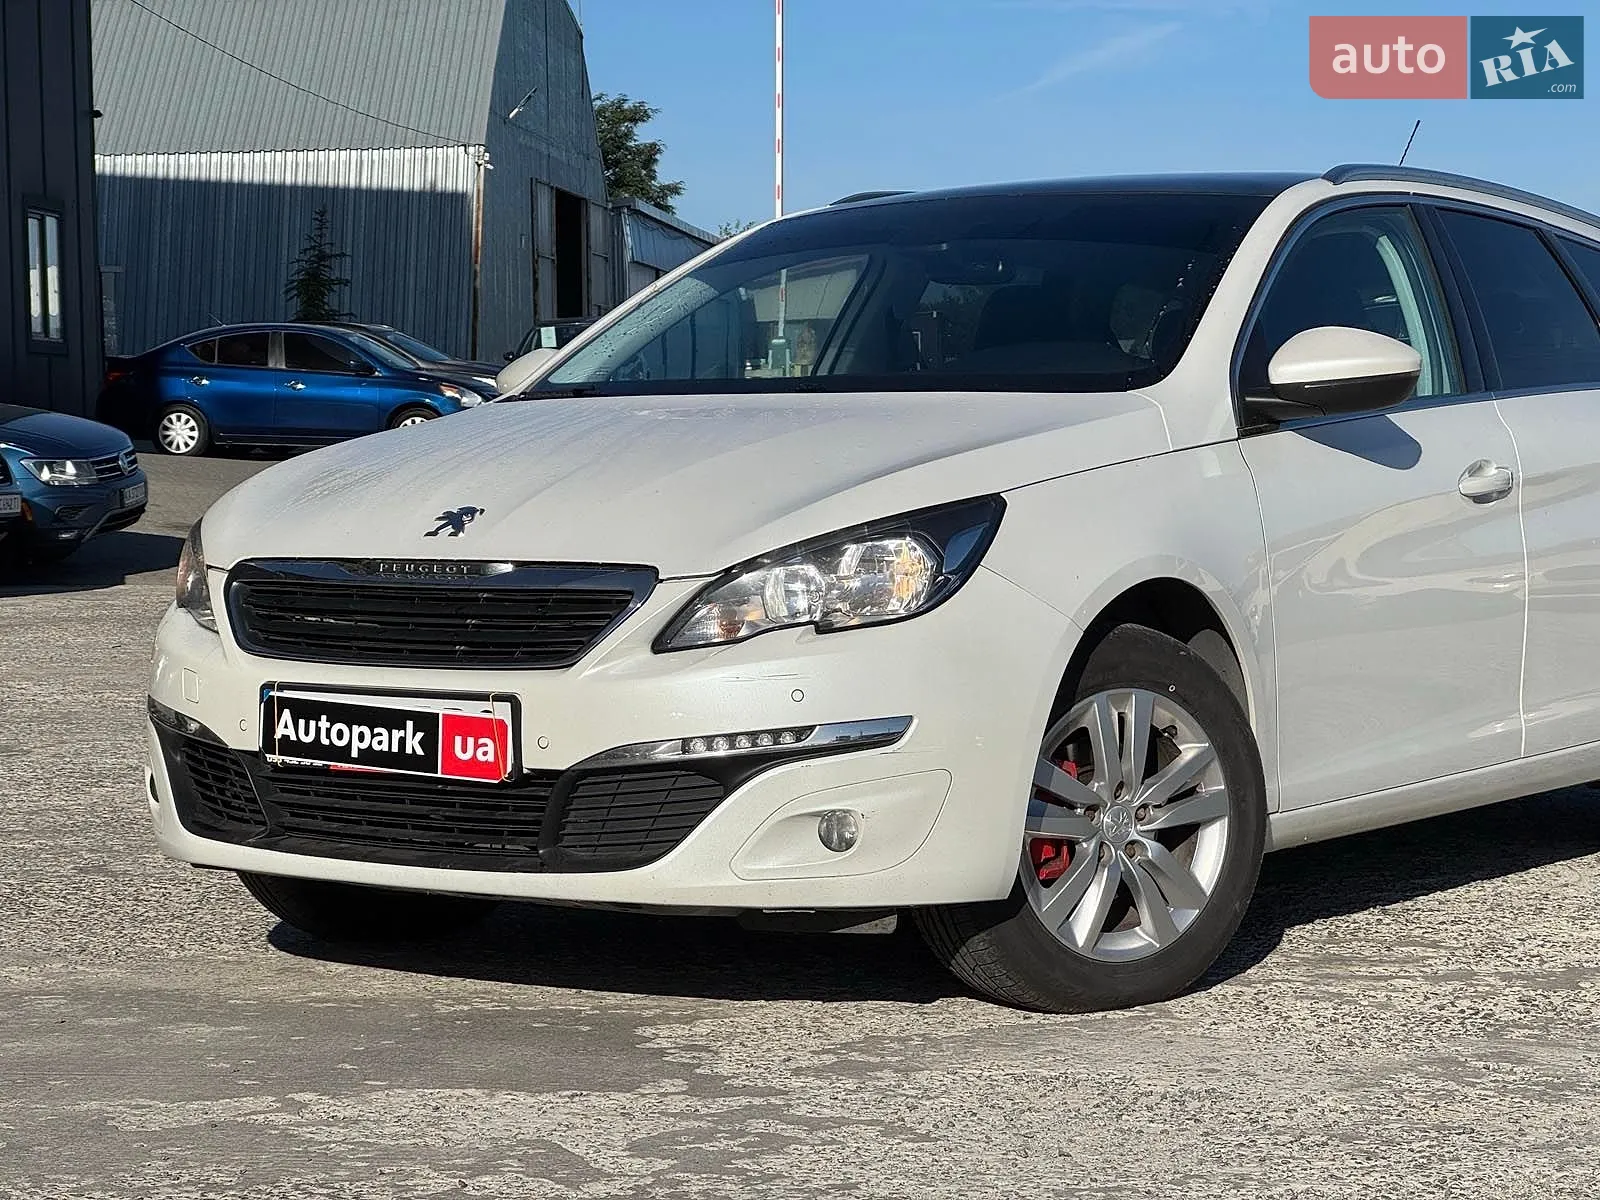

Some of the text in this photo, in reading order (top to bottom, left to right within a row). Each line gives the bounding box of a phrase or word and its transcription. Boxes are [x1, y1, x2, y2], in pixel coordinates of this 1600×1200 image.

[379, 562, 471, 574] PEUGEOT
[276, 708, 495, 762] Autopark ua
